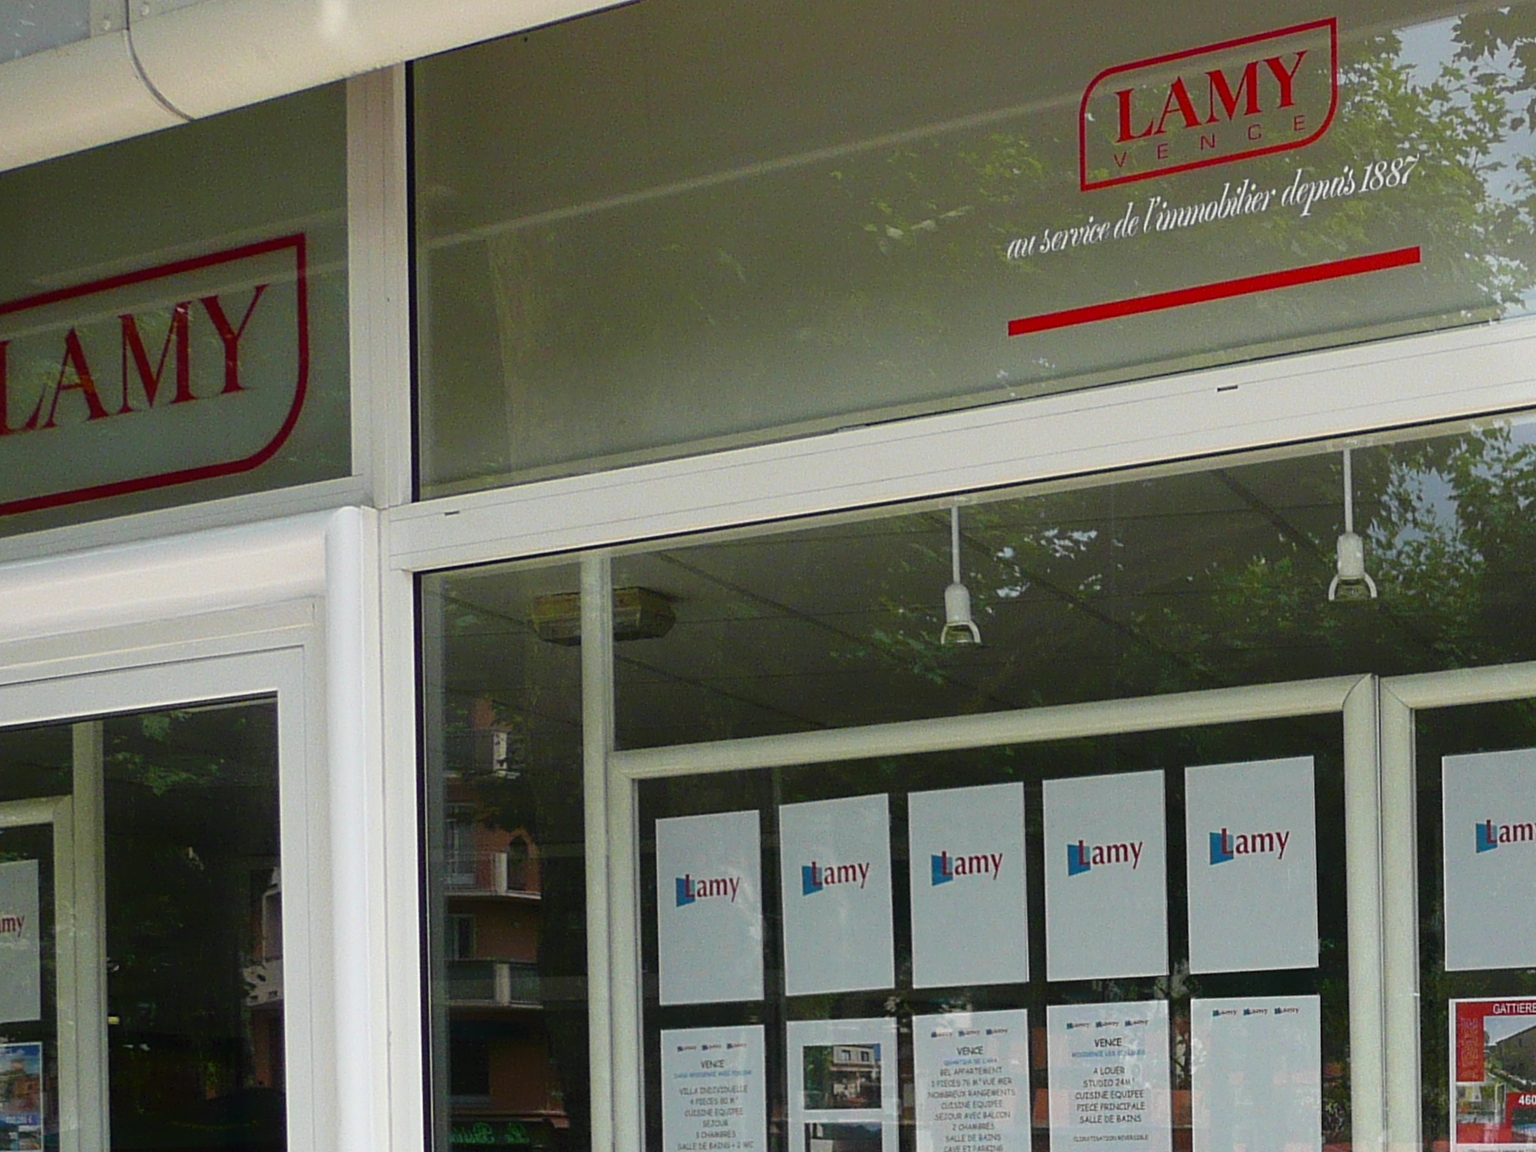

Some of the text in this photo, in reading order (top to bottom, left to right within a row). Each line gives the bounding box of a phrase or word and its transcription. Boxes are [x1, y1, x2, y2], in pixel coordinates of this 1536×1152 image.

[1115, 51, 1309, 143] LAMY
[1007, 154, 1420, 260] au service de l'immobilier depuis 1887
[0, 284, 269, 436] LAMY
[1078, 839, 1143, 869] Lamy
[1221, 828, 1290, 859] Lamy
[812, 859, 870, 888] Lamy
[942, 850, 1003, 879] Lamy
[685, 874, 740, 903] Lamy
[957, 1046, 983, 1055] VENCE
[1094, 1038, 1122, 1047] VENCE
